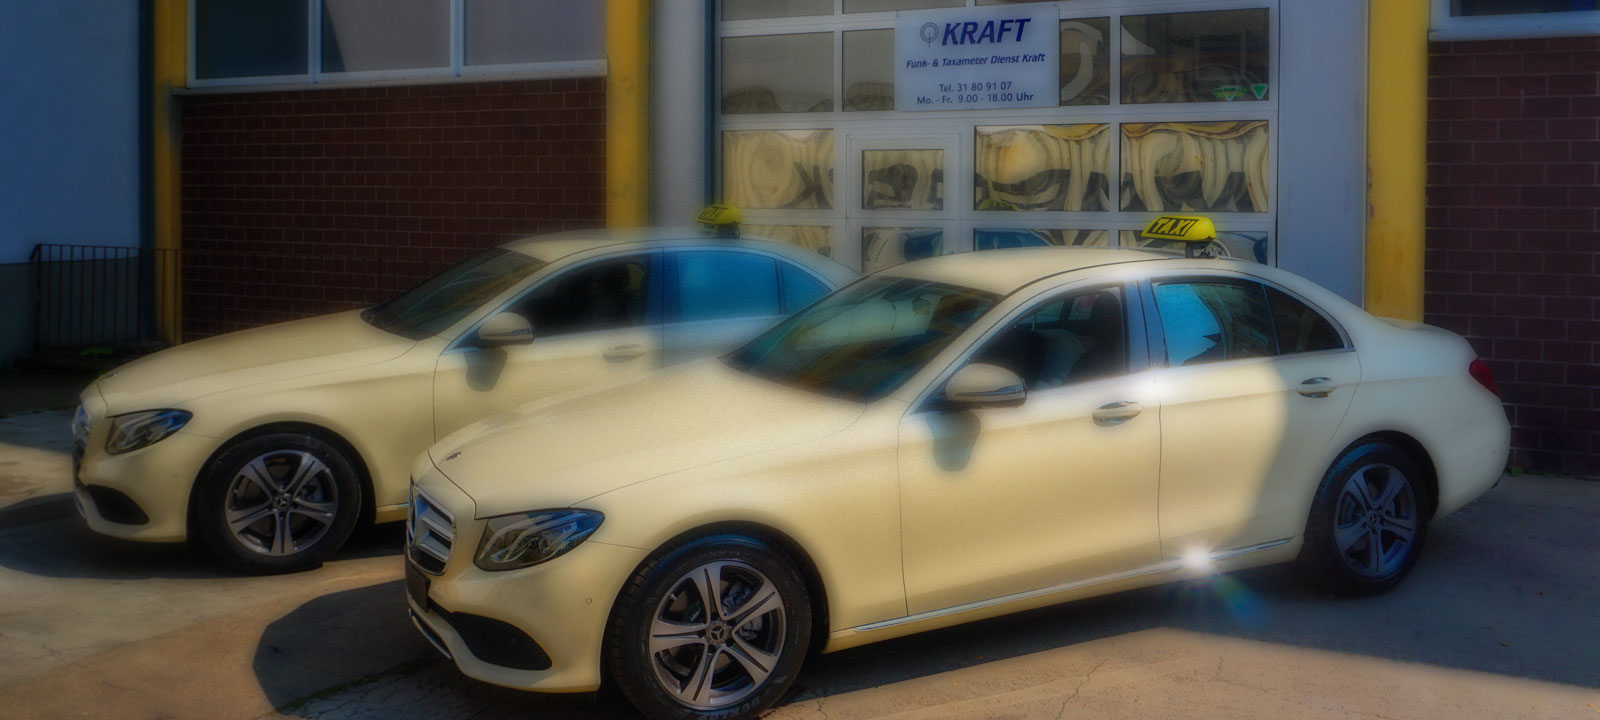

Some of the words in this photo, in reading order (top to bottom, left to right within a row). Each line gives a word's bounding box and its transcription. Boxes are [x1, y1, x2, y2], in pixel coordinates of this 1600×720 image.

[941, 17, 1031, 46] KRAFT
[906, 60, 930, 69] Funk-
[932, 58, 939, 67] &
[943, 56, 988, 67] Taxameter
[990, 55, 1020, 64] Dienst
[1022, 53, 1046, 63] Kraft
[939, 84, 954, 93] Tel.
[957, 83, 967, 92] 31
[971, 83, 983, 92] 80
[986, 82, 997, 91] 91
[1000, 81, 1012, 91] 07
[916, 96, 934, 105] Mo.
[942, 95, 953, 104] Fr.
[957, 95, 978, 103] 9.00
[988, 93, 1013, 102] 18.00
[1016, 92, 1034, 102] Uhr
[1151, 218, 1195, 235] TAXI
